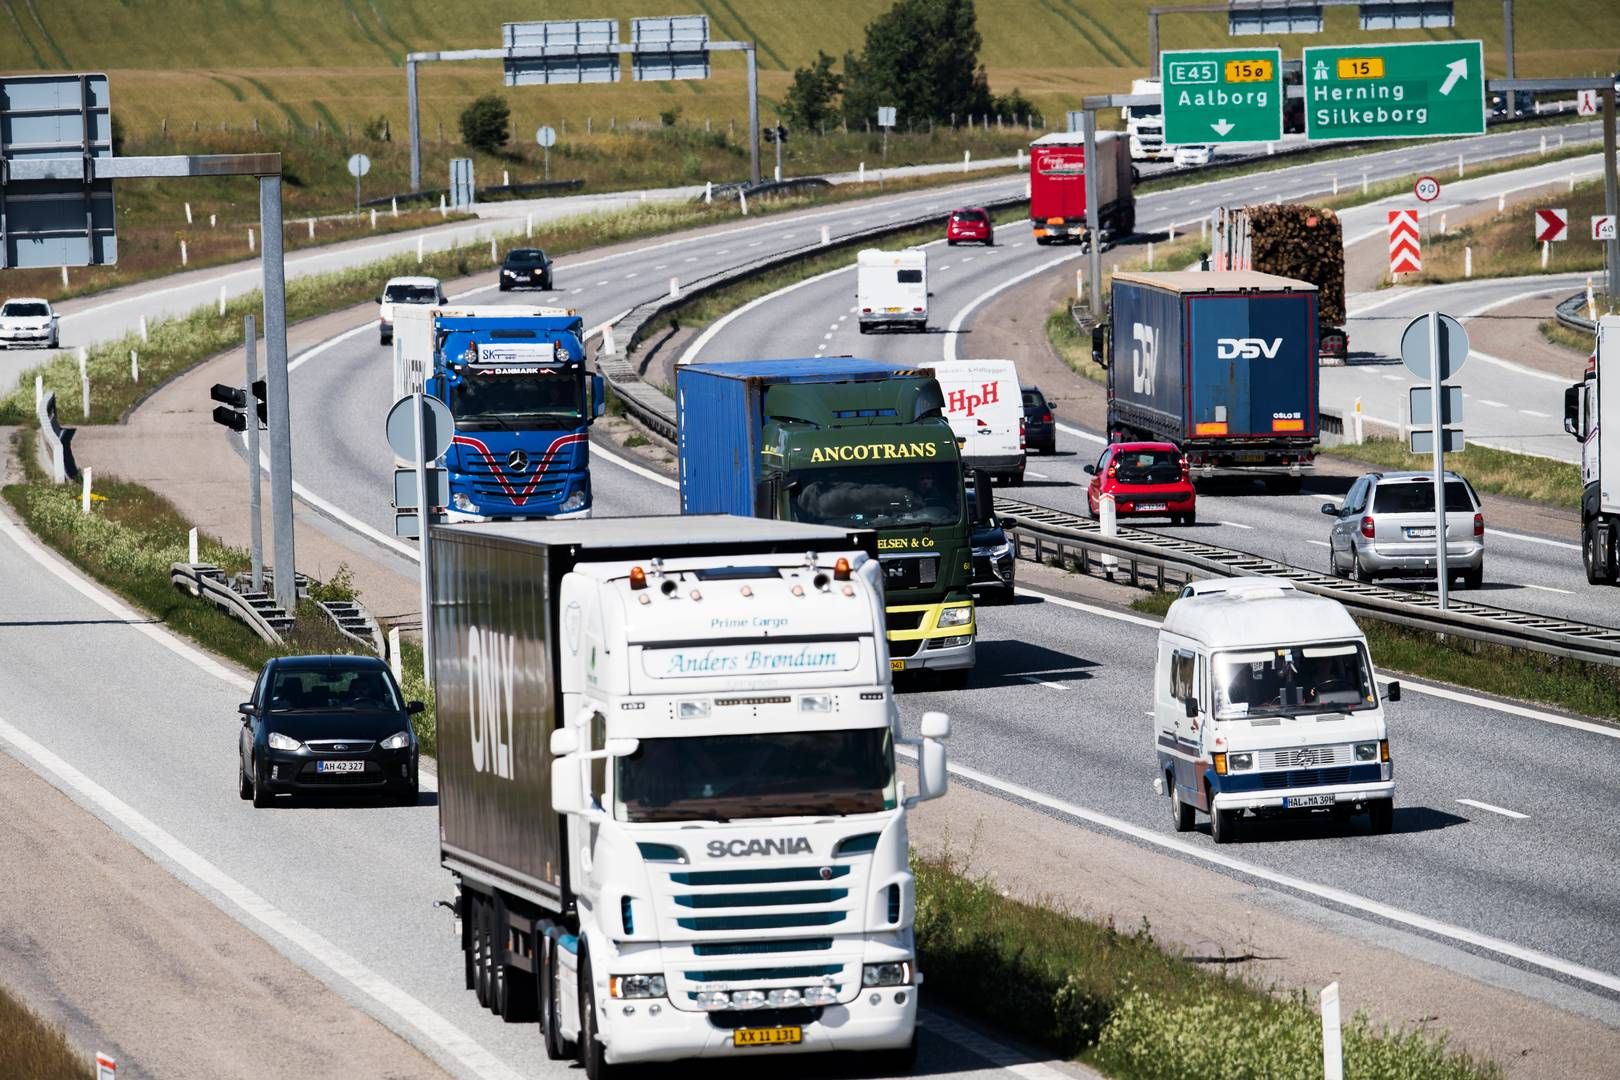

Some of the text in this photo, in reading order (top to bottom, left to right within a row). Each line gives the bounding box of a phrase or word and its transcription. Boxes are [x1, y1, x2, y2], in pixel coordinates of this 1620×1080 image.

[1176, 66, 1212, 80] E45
[1352, 62, 1370, 75] 15
[1178, 89, 1267, 107] Aalborg
[1314, 83, 1404, 101] Herning
[1317, 107, 1427, 125] Silkeborg
[1419, 183, 1436, 194] 90
[1601, 225, 1614, 233] 40
[1217, 337, 1283, 360] DSV
[947, 380, 999, 417] HpH
[810, 442, 937, 463] ANCOTRANS
[877, 537, 934, 549] ELSEN & Co
[711, 616, 789, 628] Prime Cargo
[667, 646, 837, 673] Anders Brøndum
[468, 625, 515, 781] ONLY
[324, 762, 363, 771] AH 42 327
[706, 836, 814, 858] SCANIA
[740, 1029, 794, 1042] XX 11 131
